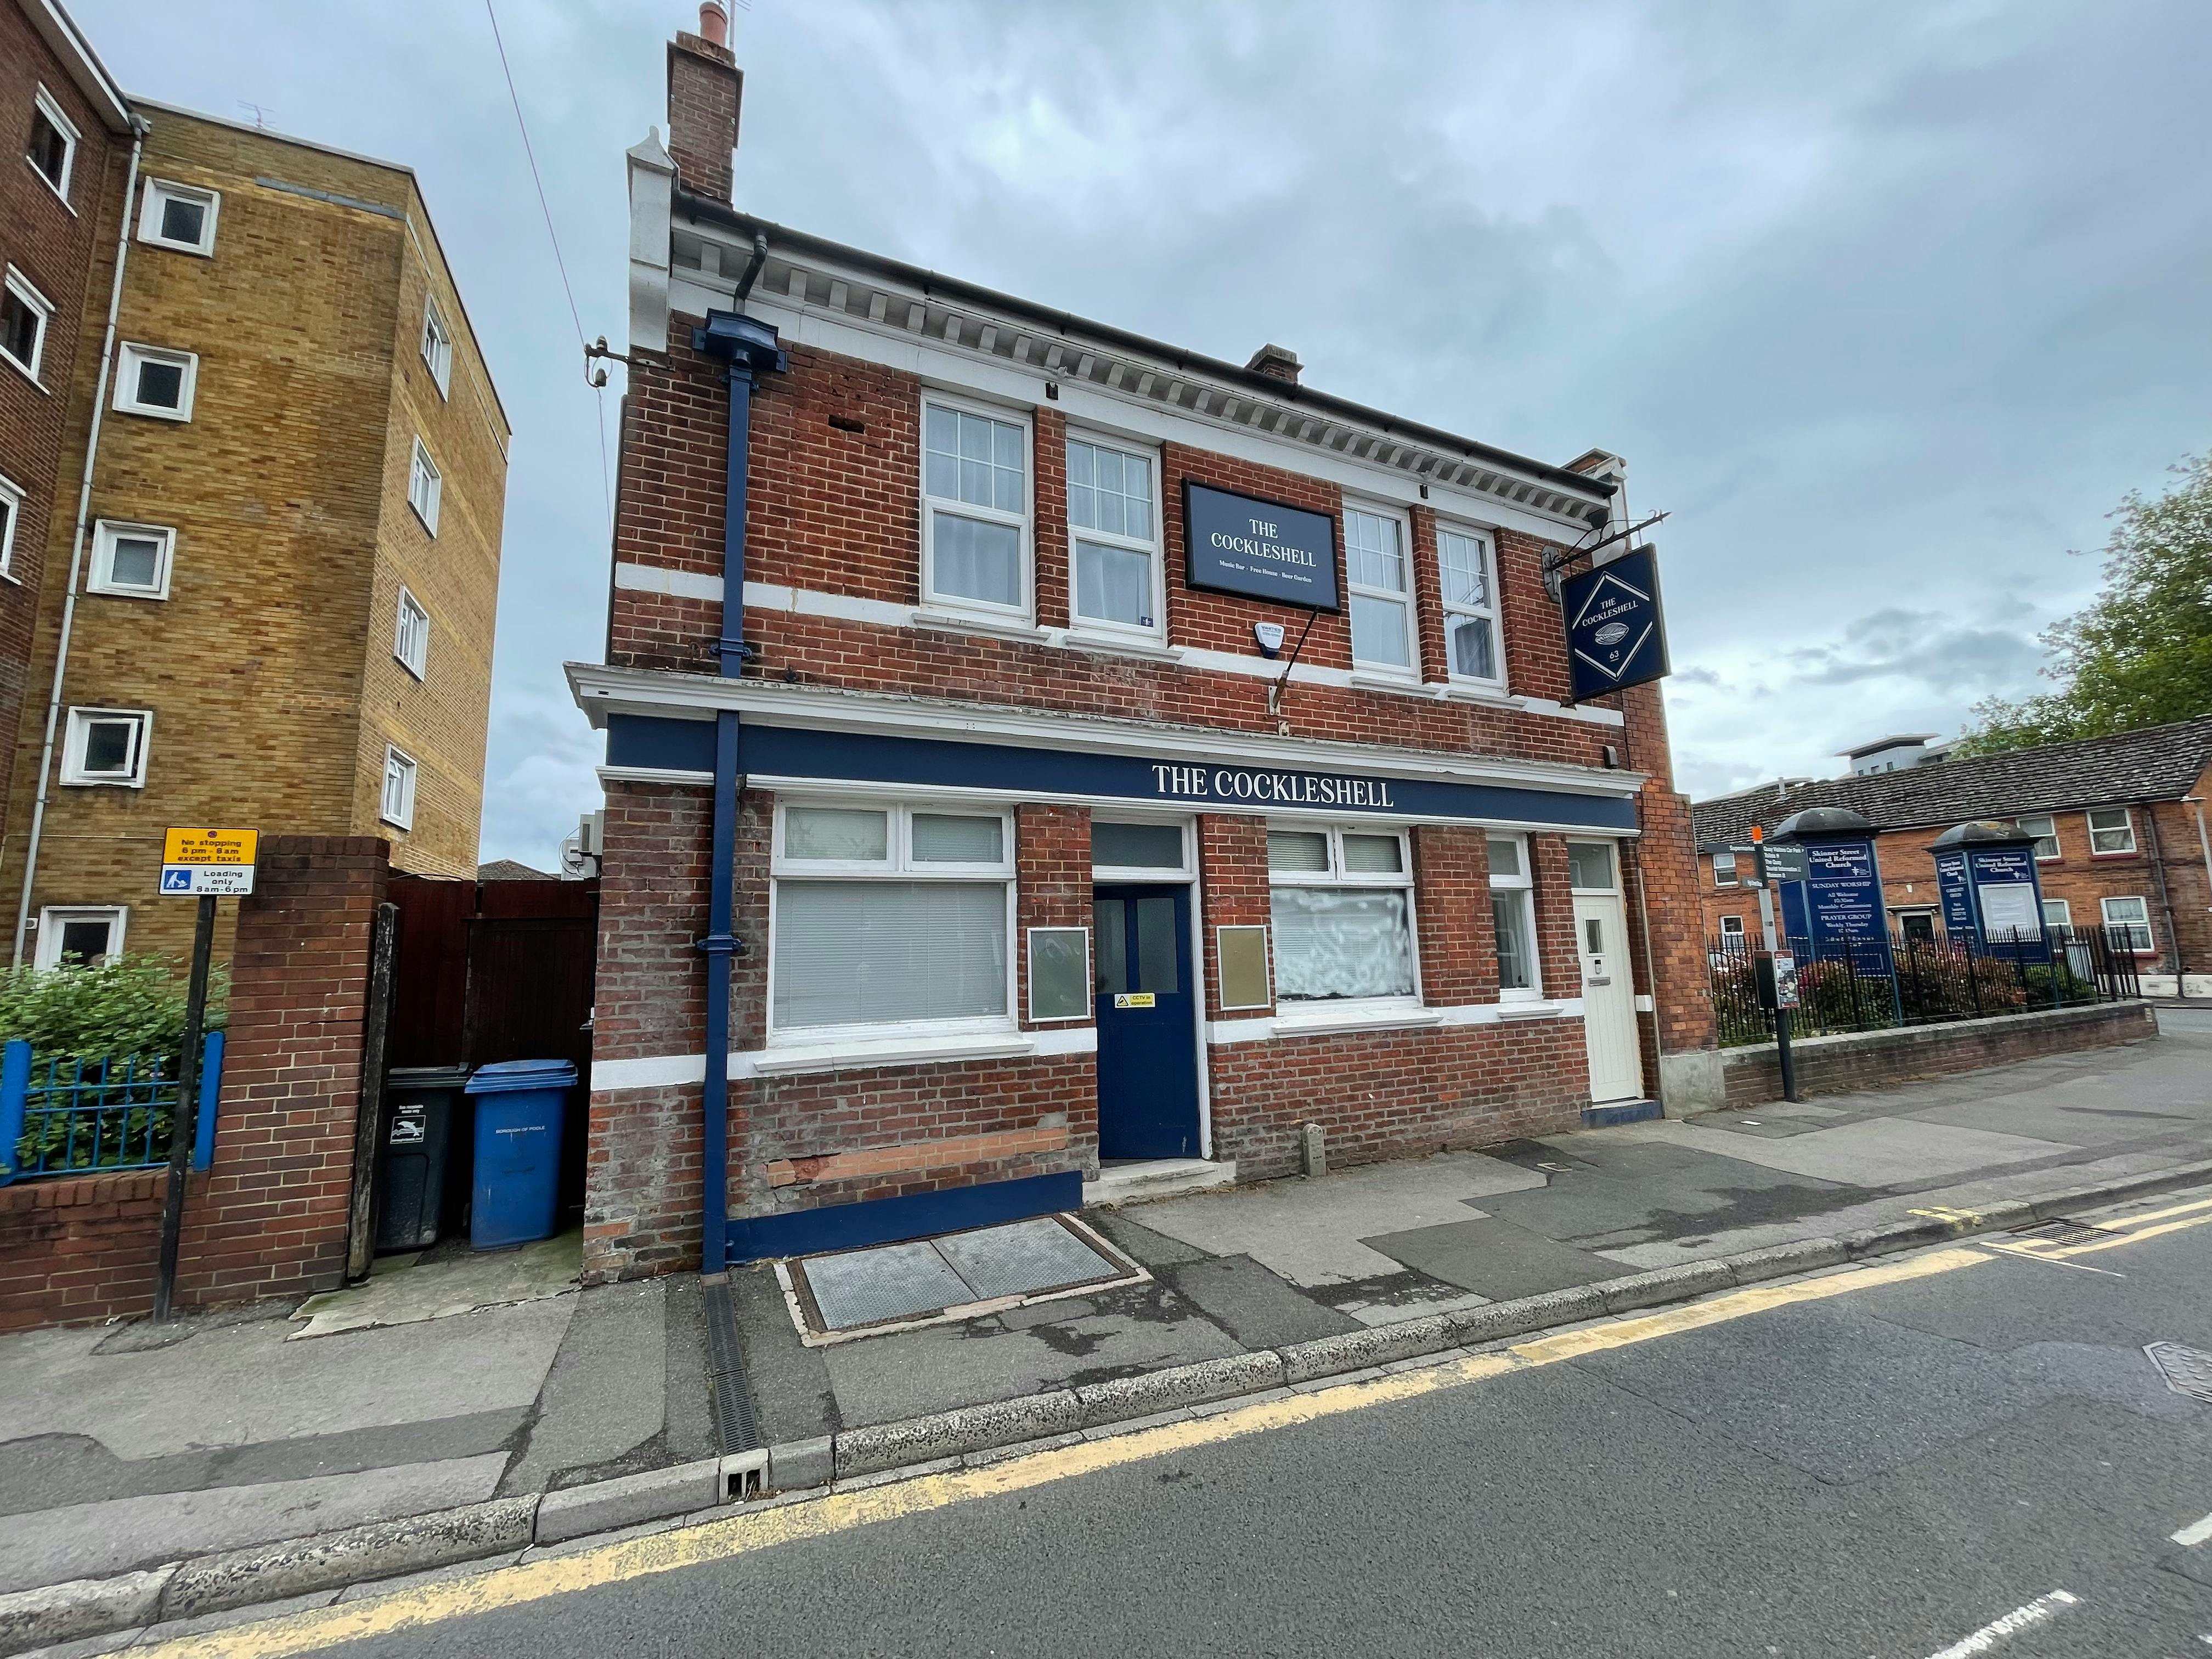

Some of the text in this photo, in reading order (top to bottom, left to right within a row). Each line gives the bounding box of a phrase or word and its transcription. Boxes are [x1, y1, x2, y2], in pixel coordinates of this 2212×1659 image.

[1249, 518, 1278, 539] THE
[1211, 532, 1317, 567] COCKLESHELL
[1219, 560, 1235, 568] Music
[1262, 568, 1278, 577] House
[1294, 574, 1312, 583] Garden
[1582, 600, 1639, 627] COCKLESHELL
[1600, 597, 1617, 610] THE
[1609, 650, 1619, 659] 63
[1152, 765, 1394, 808] THE COCKLESHELL
[1833, 854, 1867, 862] Reformed
